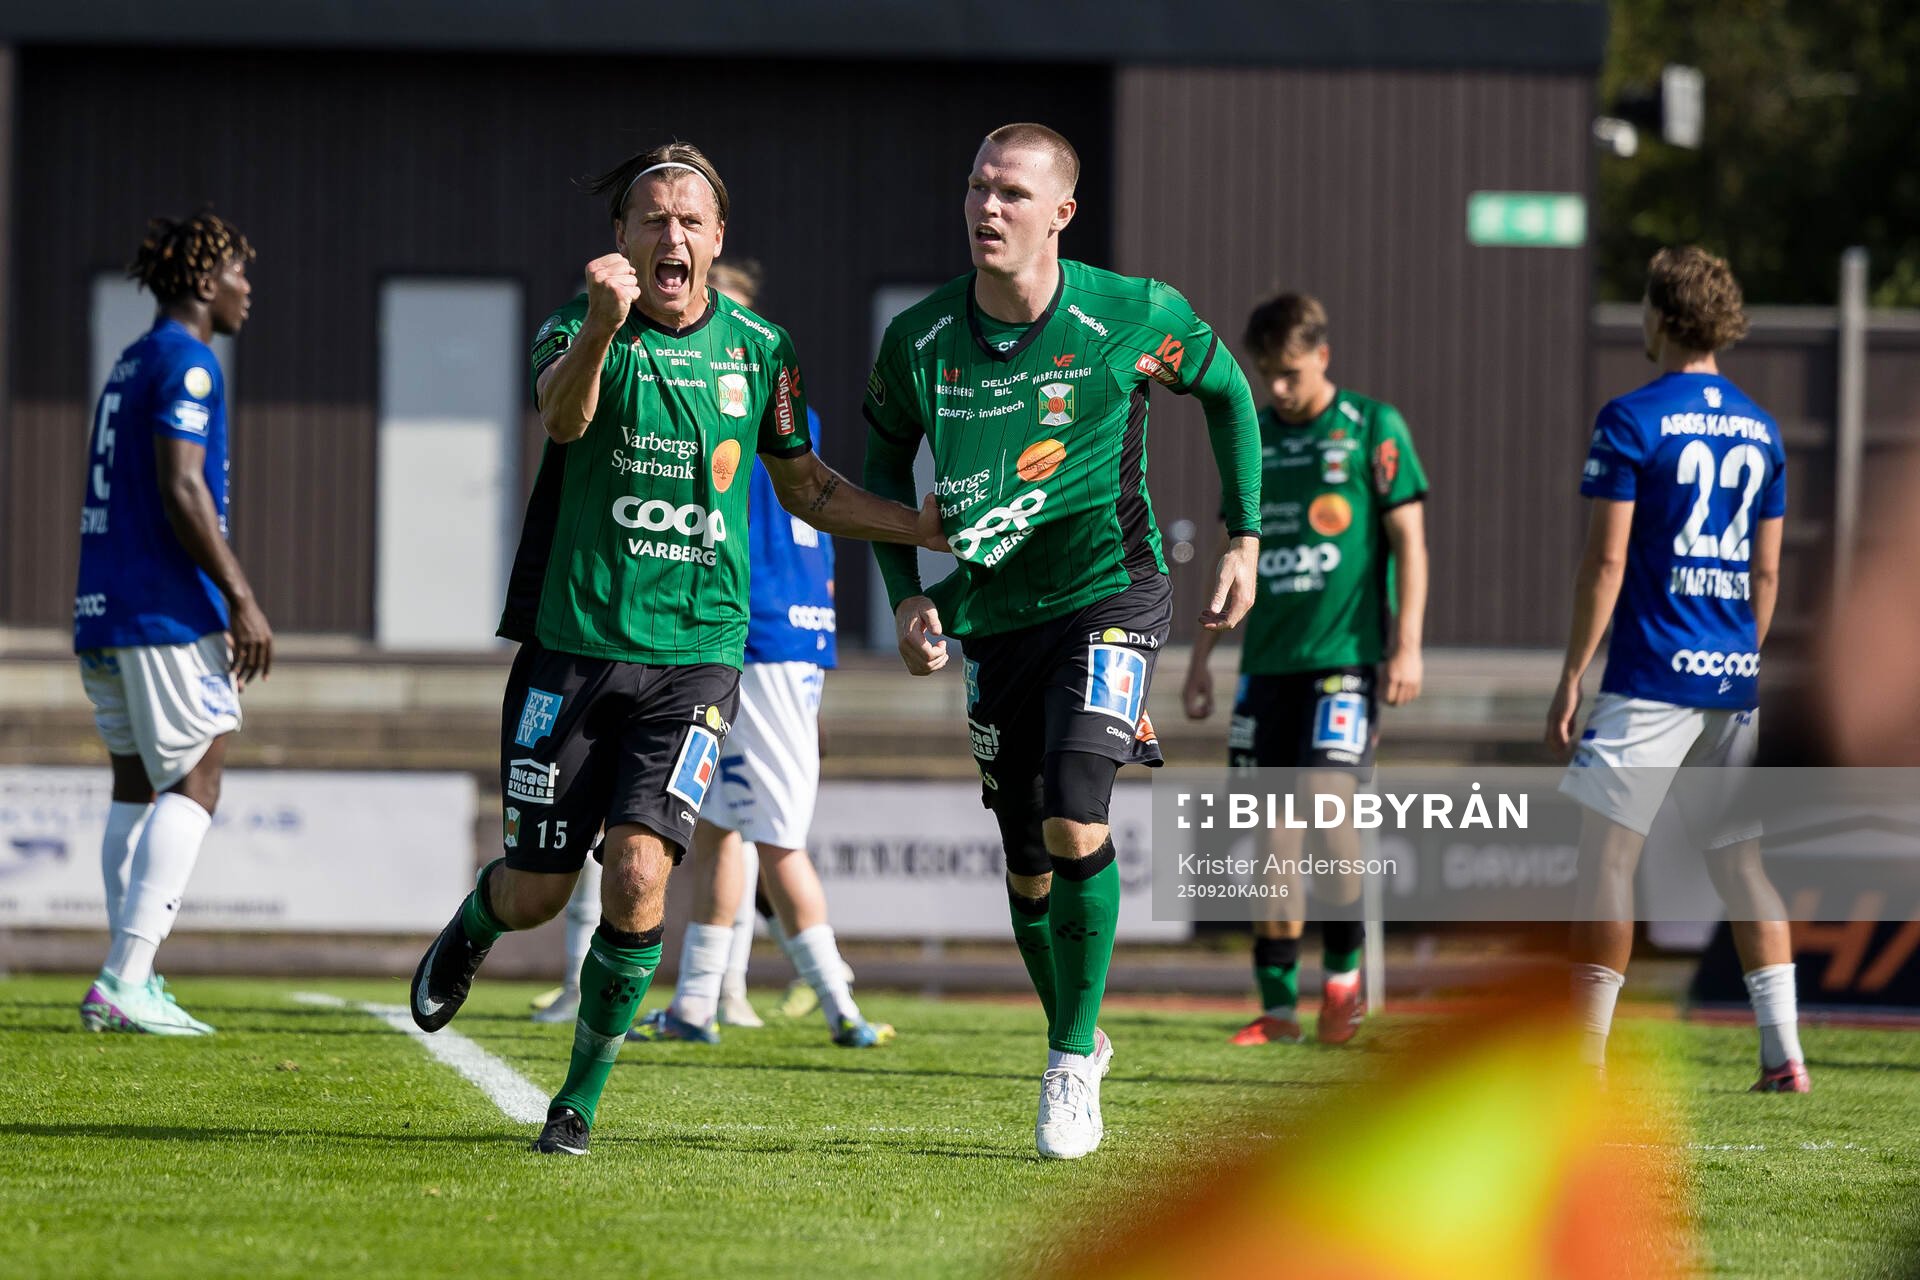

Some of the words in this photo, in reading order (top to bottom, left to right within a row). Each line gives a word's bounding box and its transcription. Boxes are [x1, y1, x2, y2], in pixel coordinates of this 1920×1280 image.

[655, 349, 702, 359] DELUXE
[670, 358, 690, 366] BIL
[981, 372, 1029, 388] DELUXE
[1032, 370, 1063, 385] VARBERG
[1064, 367, 1092, 379] ENERGI
[994, 387, 1013, 397] BIL
[937, 407, 967, 420] CRAFT
[978, 400, 1025, 419] inviatech
[621, 426, 699, 459] Varbergs
[611, 449, 697, 480] Sparbank
[1673, 439, 1766, 562] 22
[612, 495, 727, 549] coop
[628, 538, 717, 567] VARBERG
[522, 709, 553, 731] EKT
[508, 779, 555, 798] BYGGARE
[537, 820, 568, 850] 15
